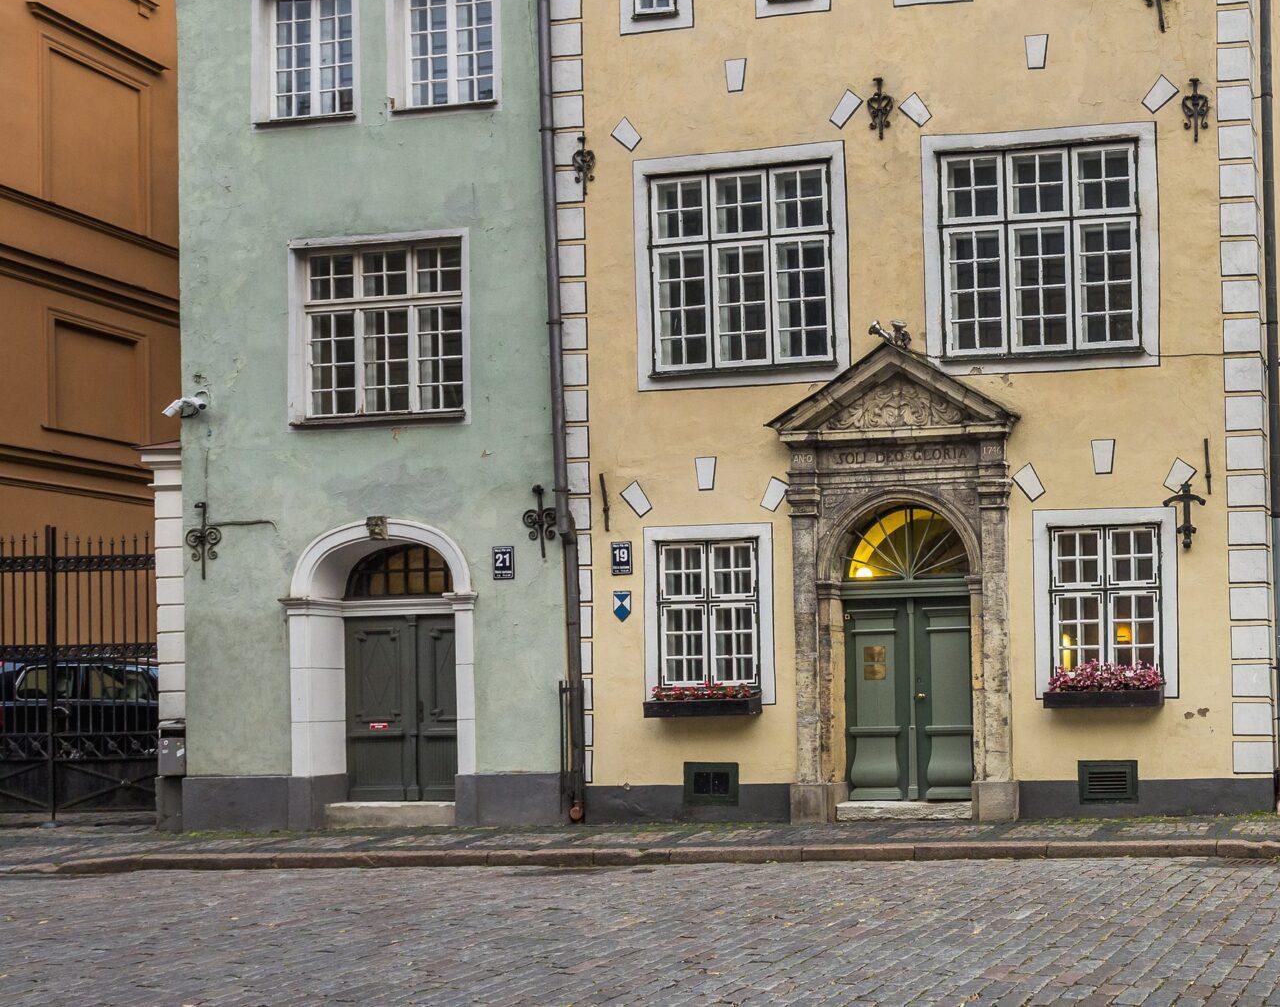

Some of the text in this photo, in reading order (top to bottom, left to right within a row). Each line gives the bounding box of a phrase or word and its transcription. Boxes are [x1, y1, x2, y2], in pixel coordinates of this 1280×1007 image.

[835, 447, 968, 465] SOLI DEO GLORIA
[495, 553, 510, 567] 21
[613, 548, 628, 562] 19
